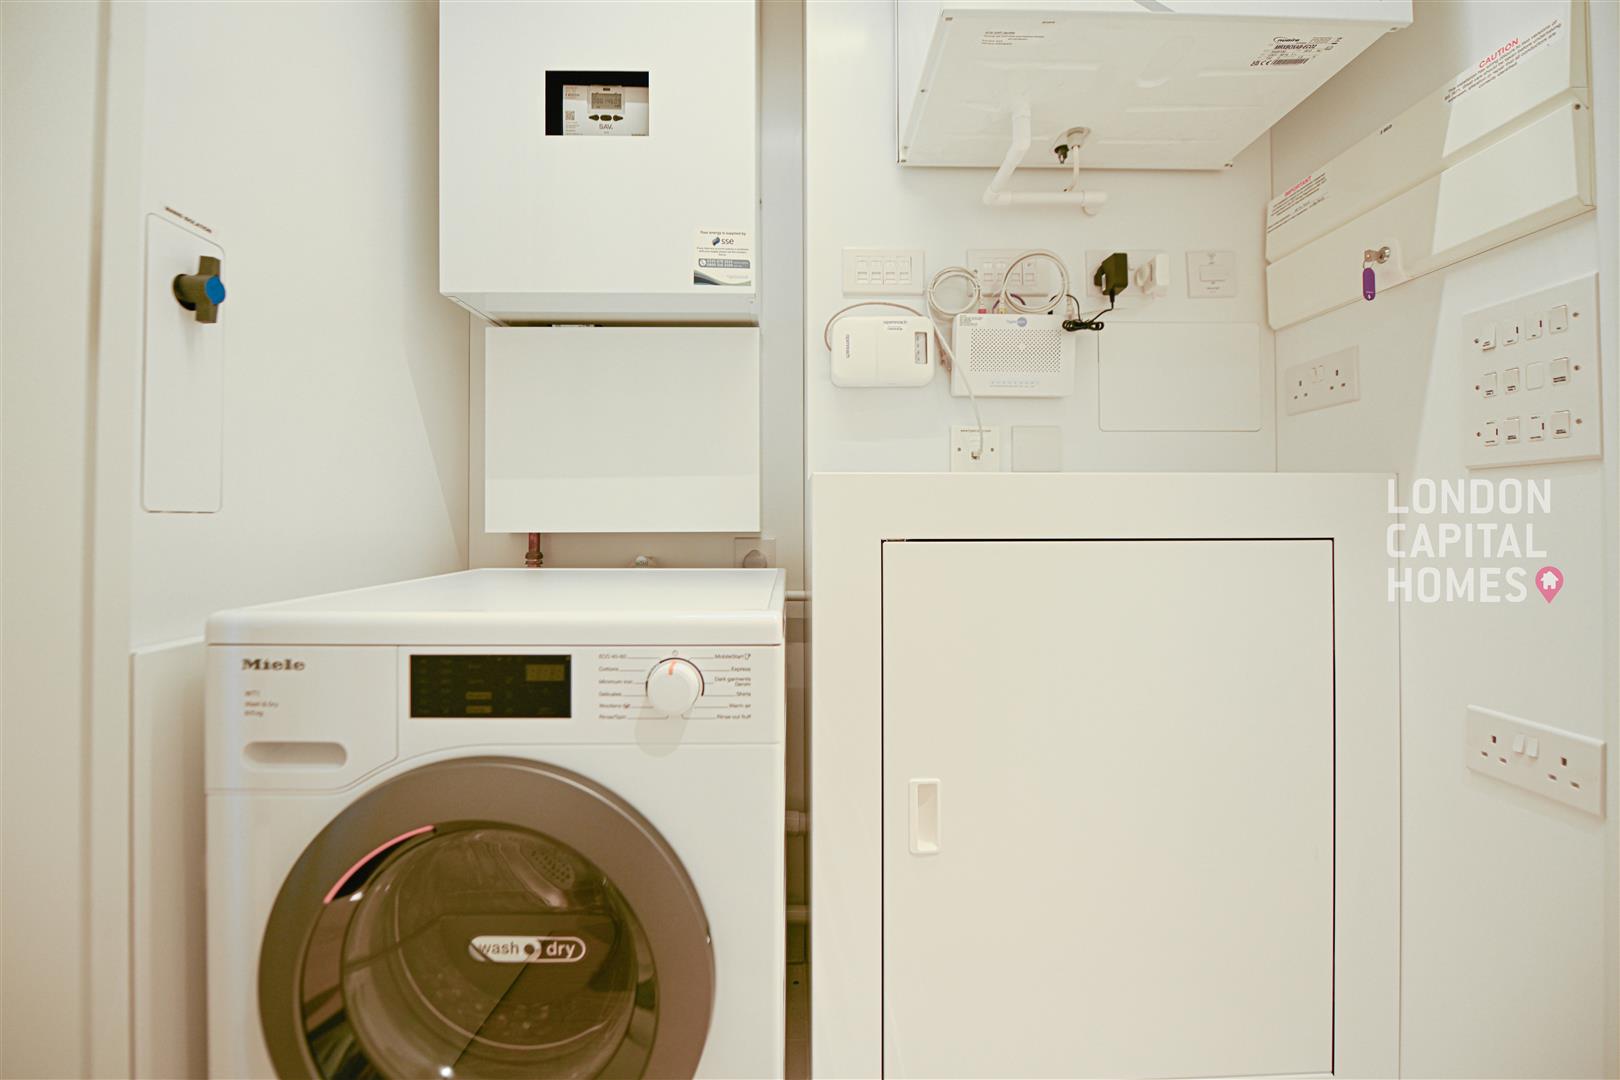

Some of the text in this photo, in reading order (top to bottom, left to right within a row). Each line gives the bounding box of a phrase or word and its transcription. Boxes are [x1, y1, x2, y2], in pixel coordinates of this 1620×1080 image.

[1479, 38, 1520, 69] CAUTION
[242, 658, 305, 671] Miele
[479, 941, 576, 959] wash dry
